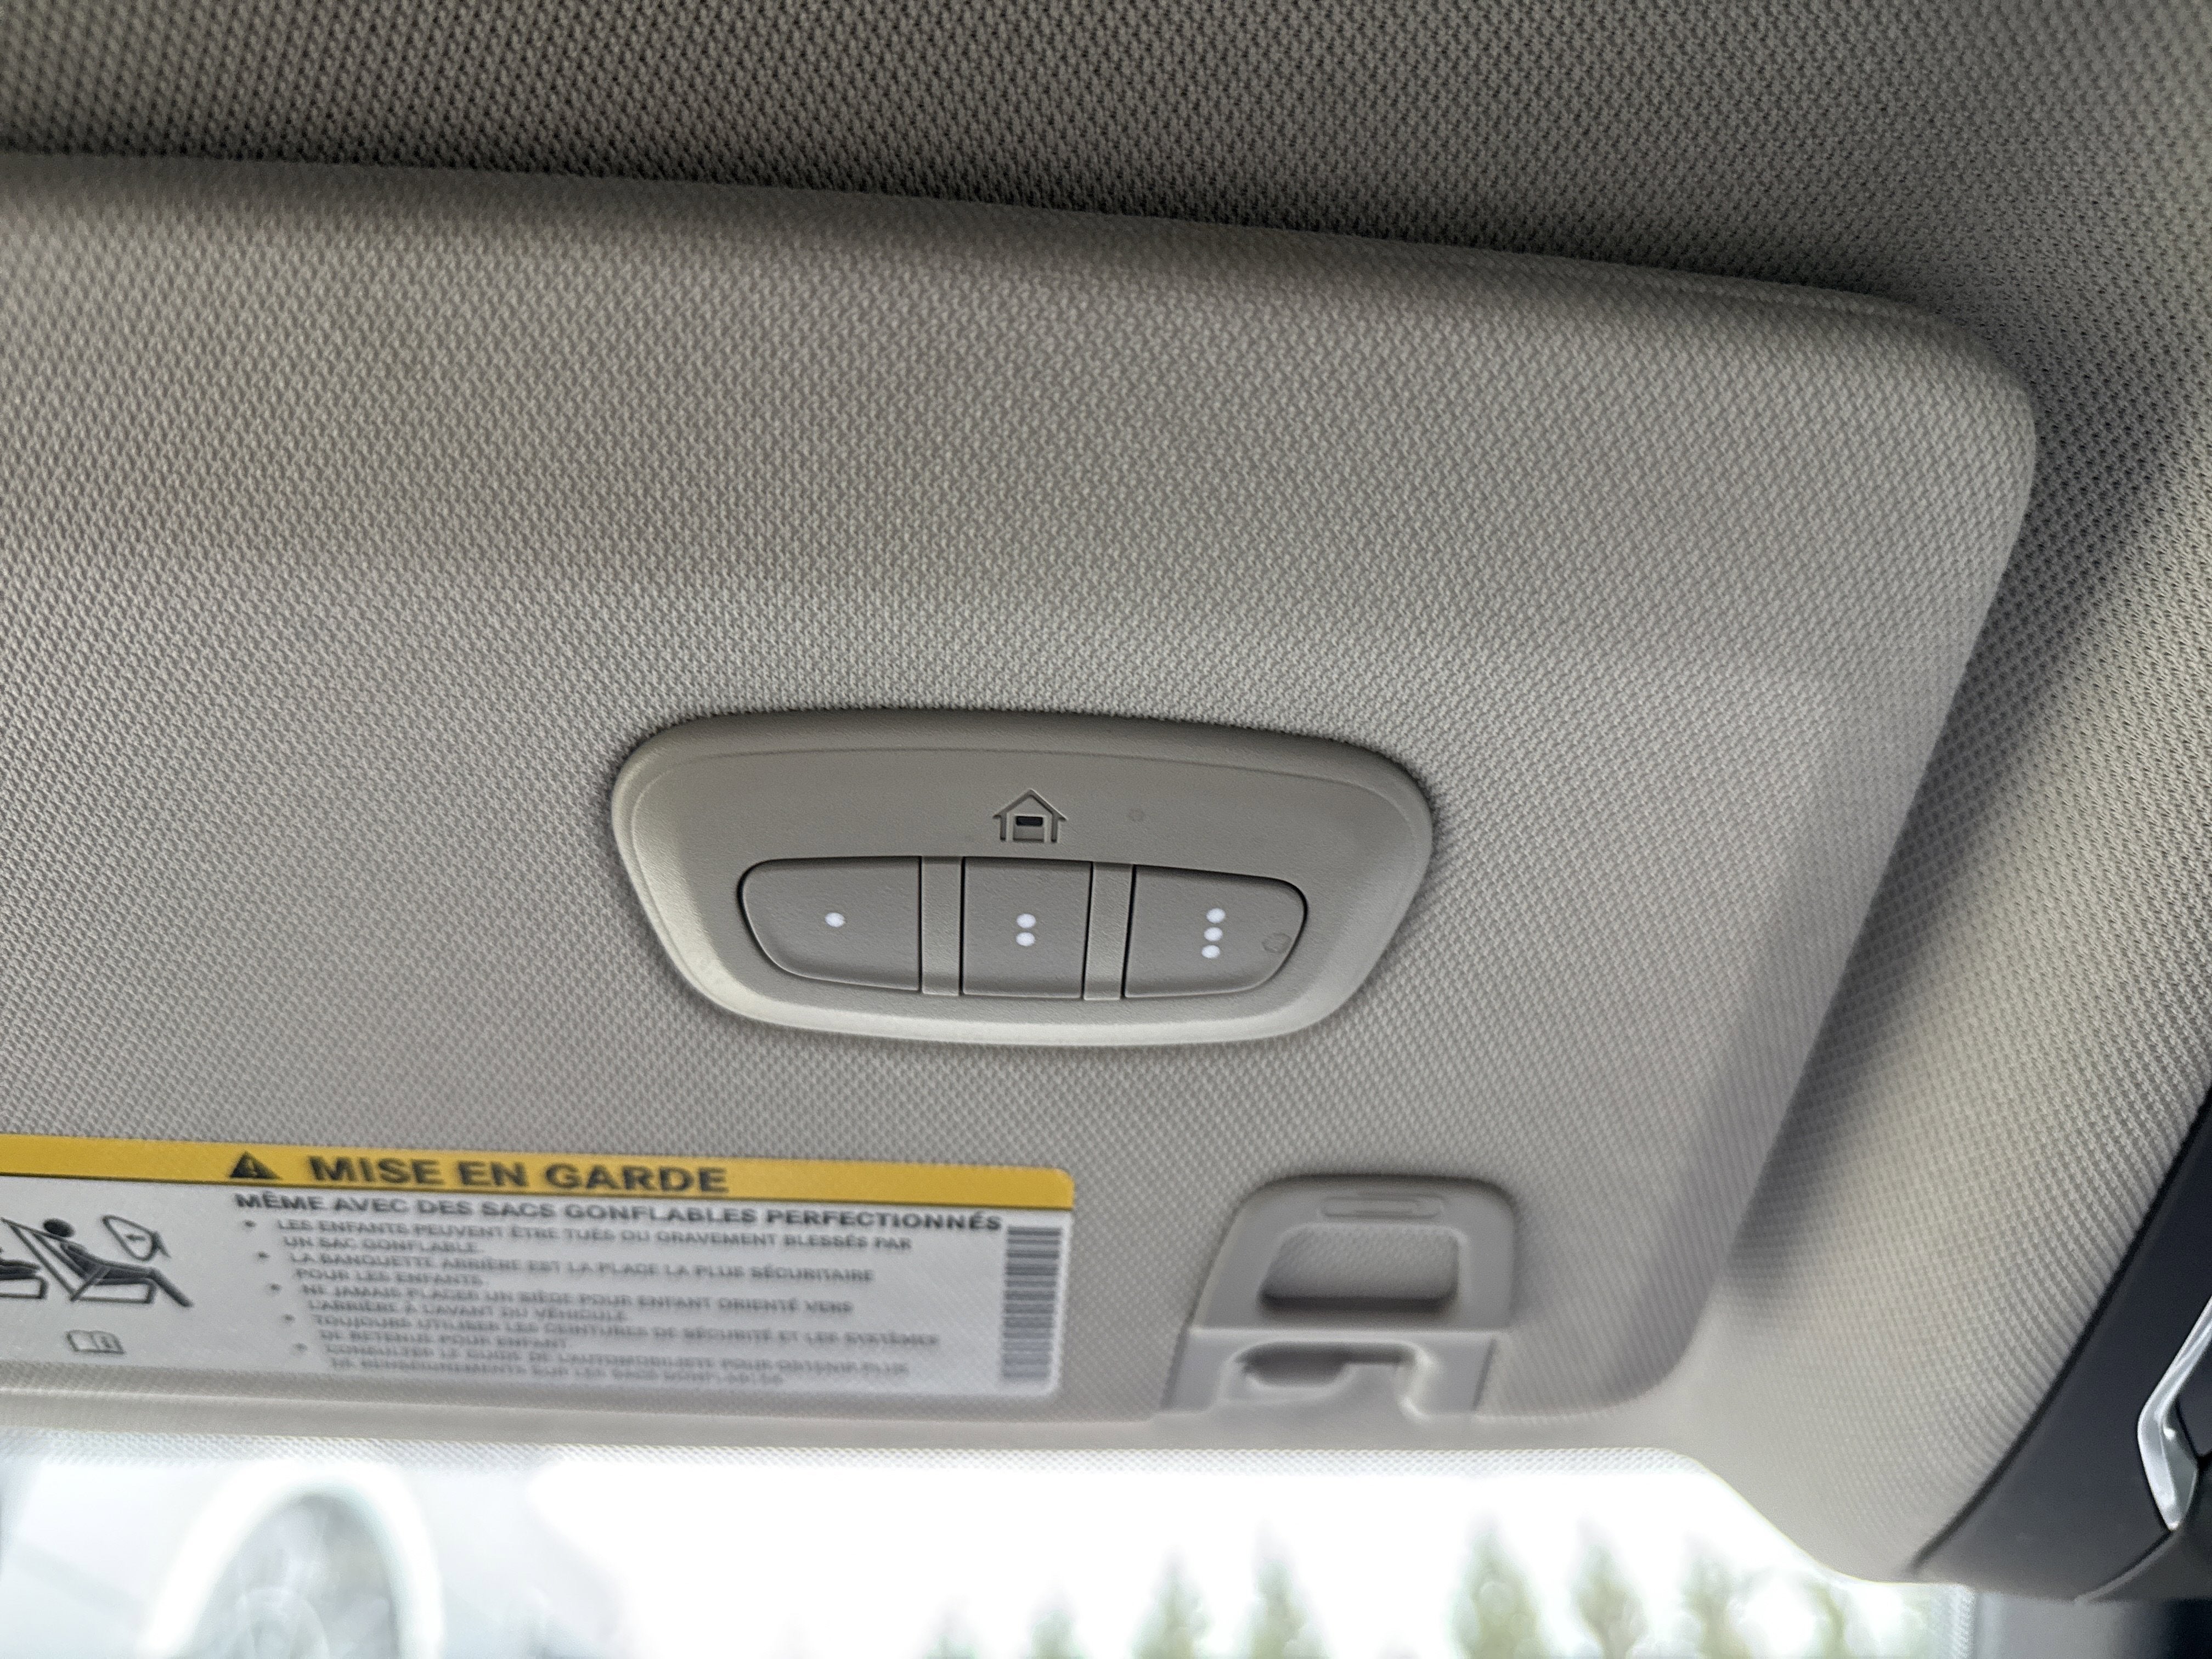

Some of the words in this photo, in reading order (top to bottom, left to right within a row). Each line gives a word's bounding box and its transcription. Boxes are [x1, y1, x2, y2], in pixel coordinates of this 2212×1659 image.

[309, 1155, 444, 1184] MISE
[458, 1160, 529, 1187] EN
[545, 1163, 728, 1193] GARDE
[235, 1192, 325, 1210] MÊME
[334, 1198, 410, 1213] AVEC
[417, 1199, 474, 1216] DES
[478, 1201, 554, 1217] SACS
[564, 1203, 757, 1224] GONFLABLES
[768, 1209, 1002, 1231] PERFECTIONNÉS
[277, 1219, 313, 1231] LES
[317, 1220, 409, 1234] ENFANTS
[413, 1223, 503, 1237] PEUVENT
[657, 1231, 775, 1245] GRAVEMENT
[783, 1233, 868, 1248] BLESSÉS
[874, 1236, 912, 1250] PAR
[284, 1236, 314, 1247] UN
[290, 1252, 316, 1262] LA
[567, 1262, 595, 1273] LA
[664, 1264, 689, 1276] LA
